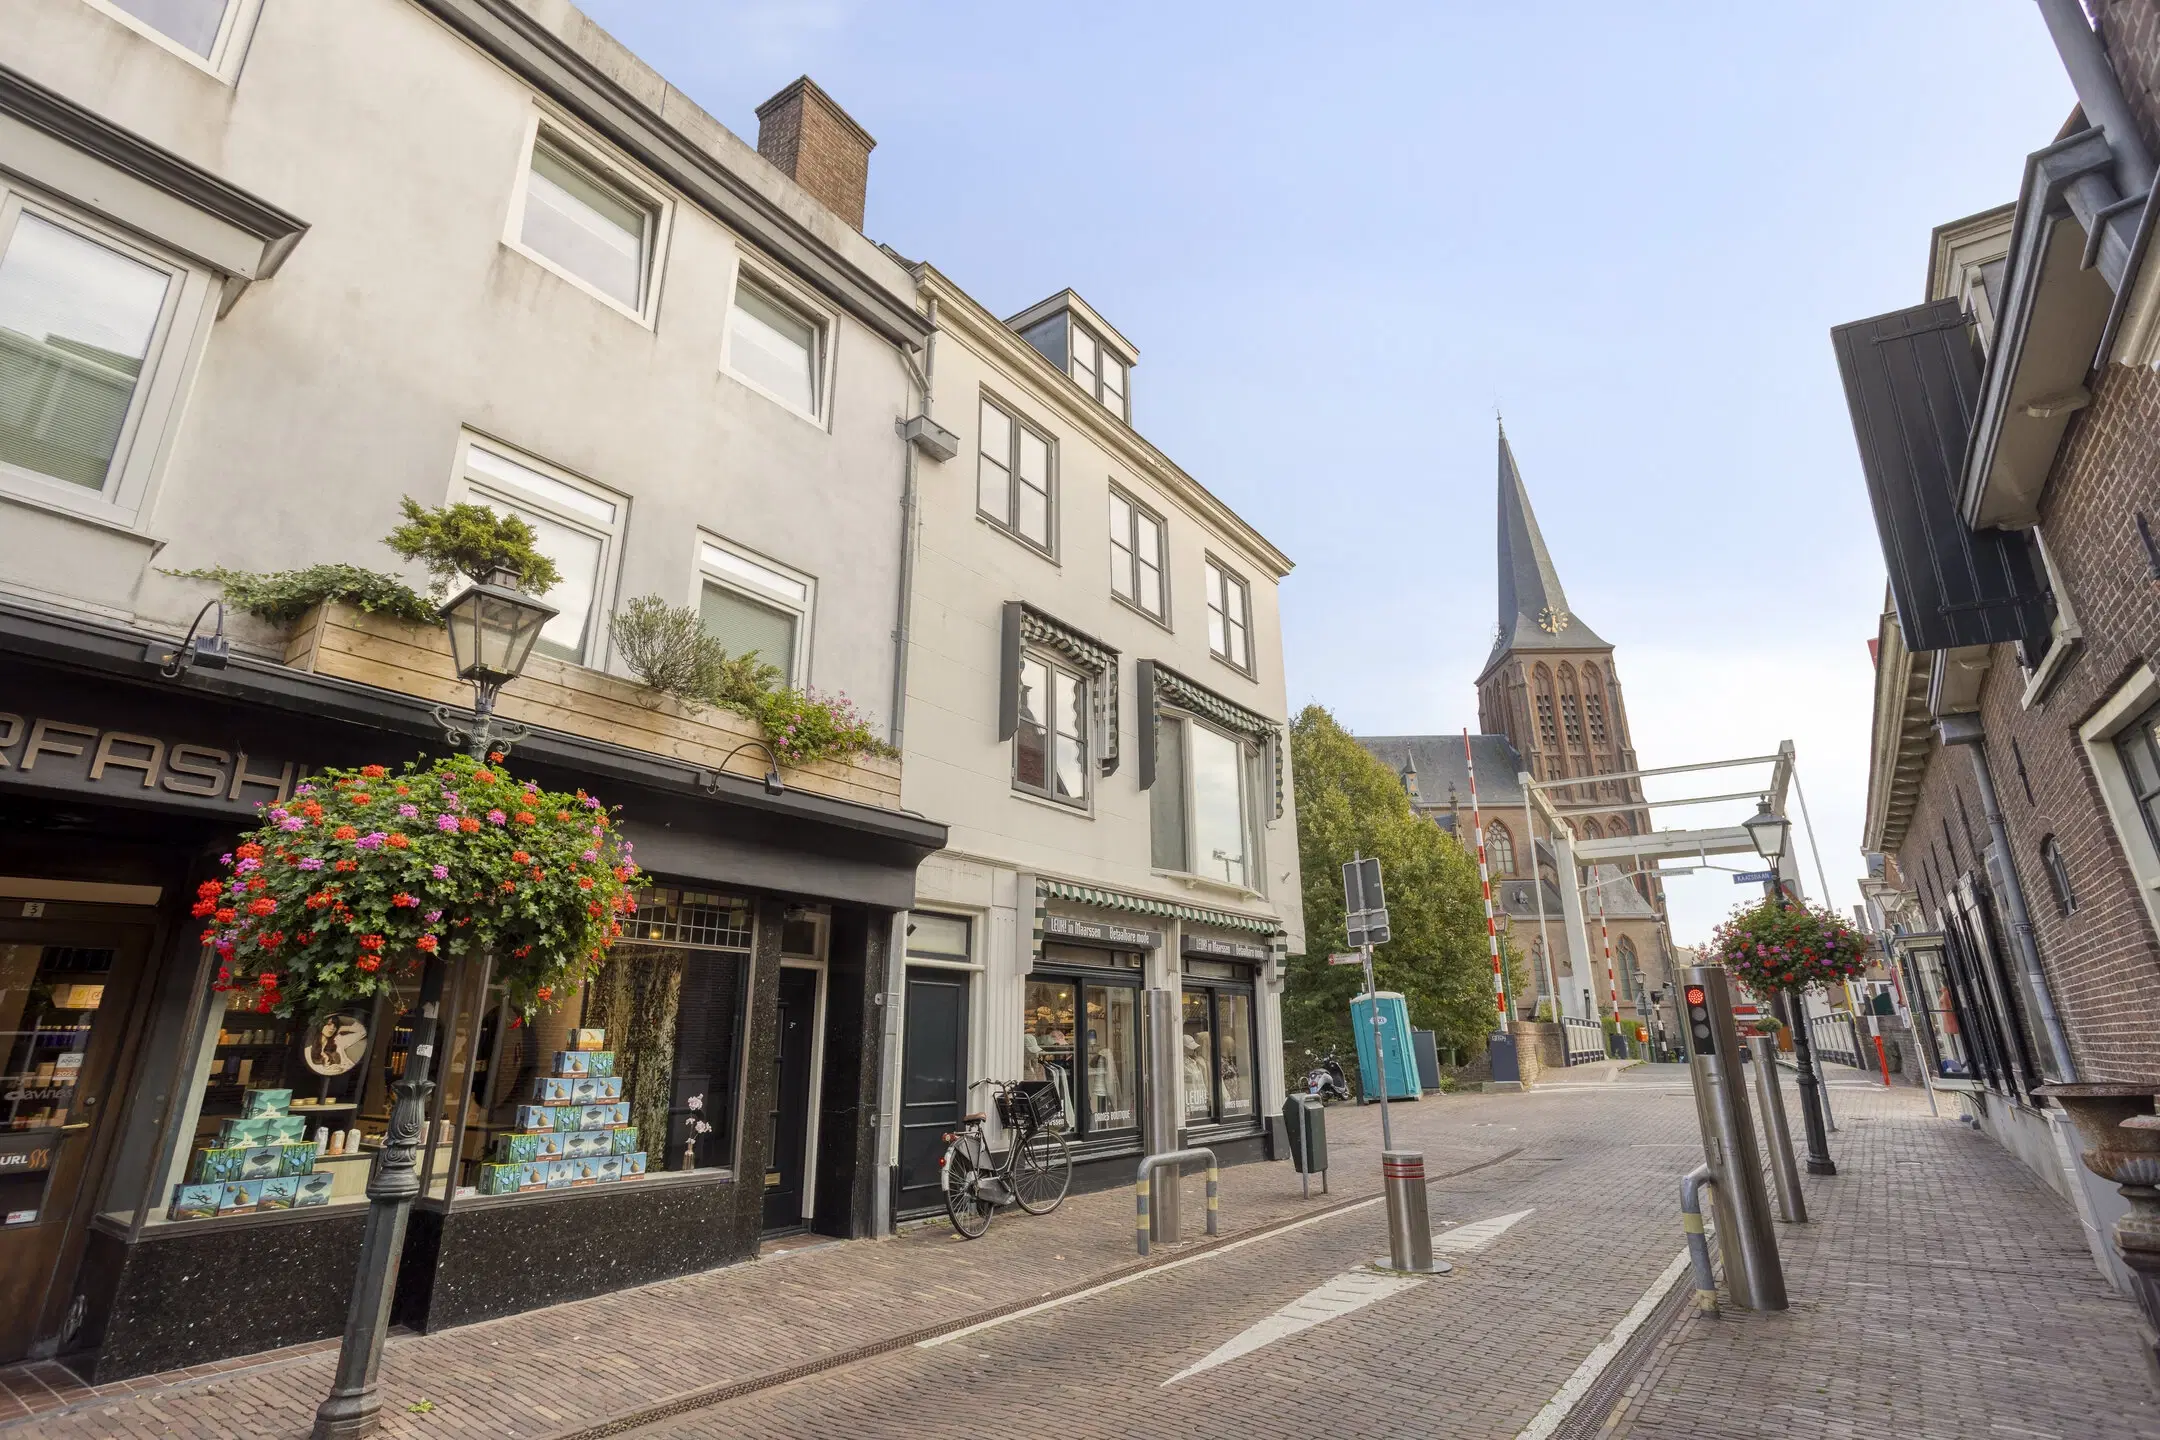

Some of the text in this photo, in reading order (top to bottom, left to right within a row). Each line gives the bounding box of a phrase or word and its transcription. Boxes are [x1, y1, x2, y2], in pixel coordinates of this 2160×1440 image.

[1051, 917, 1101, 938] LEUK! in Maarssen
[1109, 926, 1150, 944] Betaalbare mode
[1213, 940, 1231, 954] Maarssen
[1255, 947, 1264, 958] mode
[1185, 1090, 1207, 1105] LEUK!
[1094, 1110, 1131, 1122] DAMES BOUTIQUE
